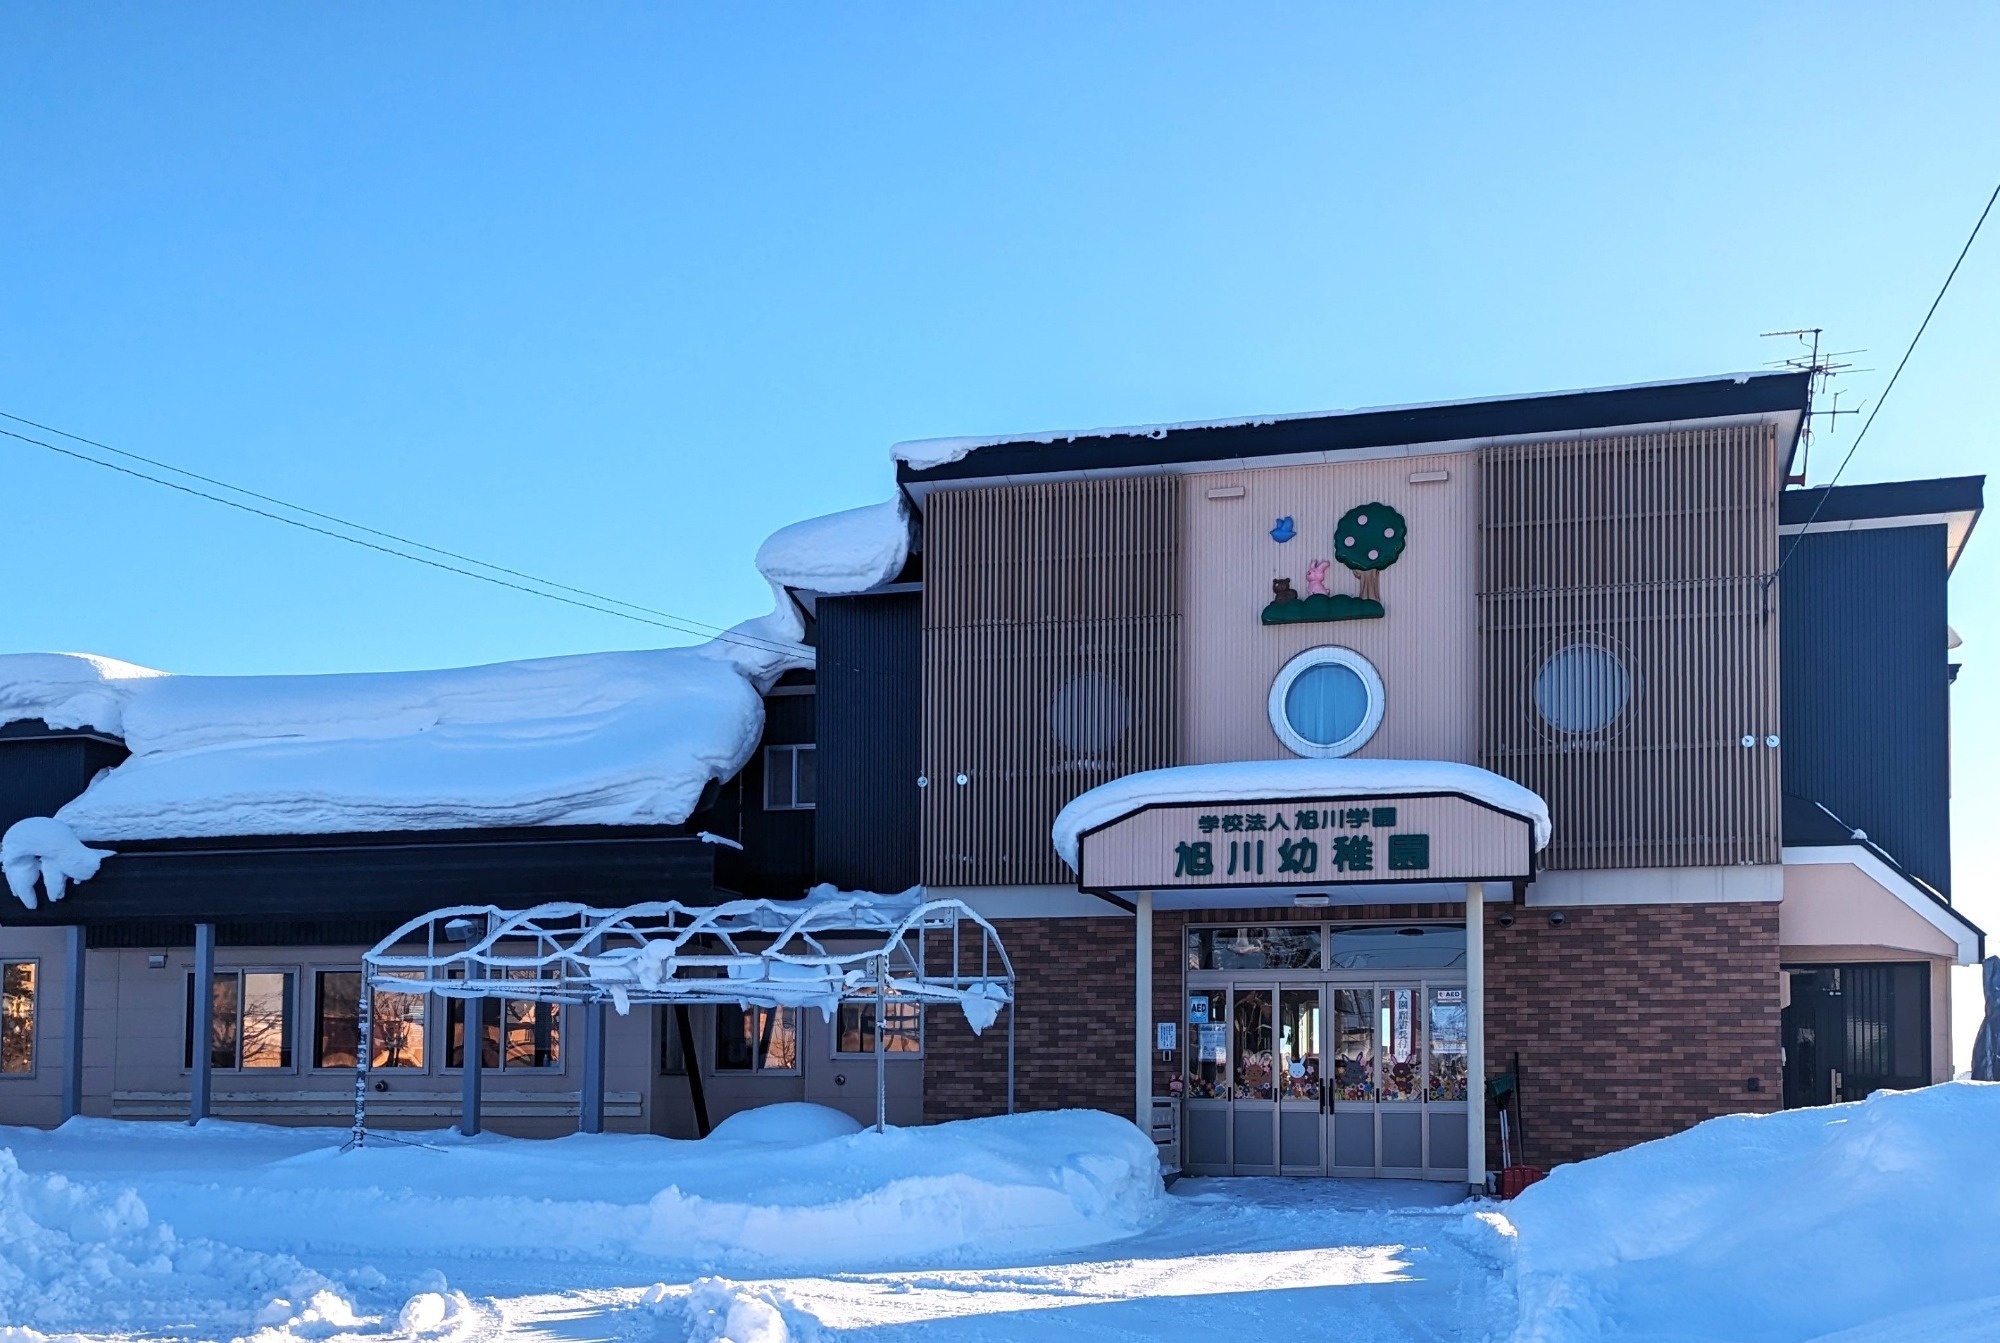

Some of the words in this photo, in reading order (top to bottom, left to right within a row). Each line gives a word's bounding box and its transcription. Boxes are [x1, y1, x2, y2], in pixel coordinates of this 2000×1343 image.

[1198, 807, 1397, 833] 学校法人旭川学園
[1174, 834, 1430, 877] 旭川幼稚園
[1191, 1004, 1206, 1013] AED
